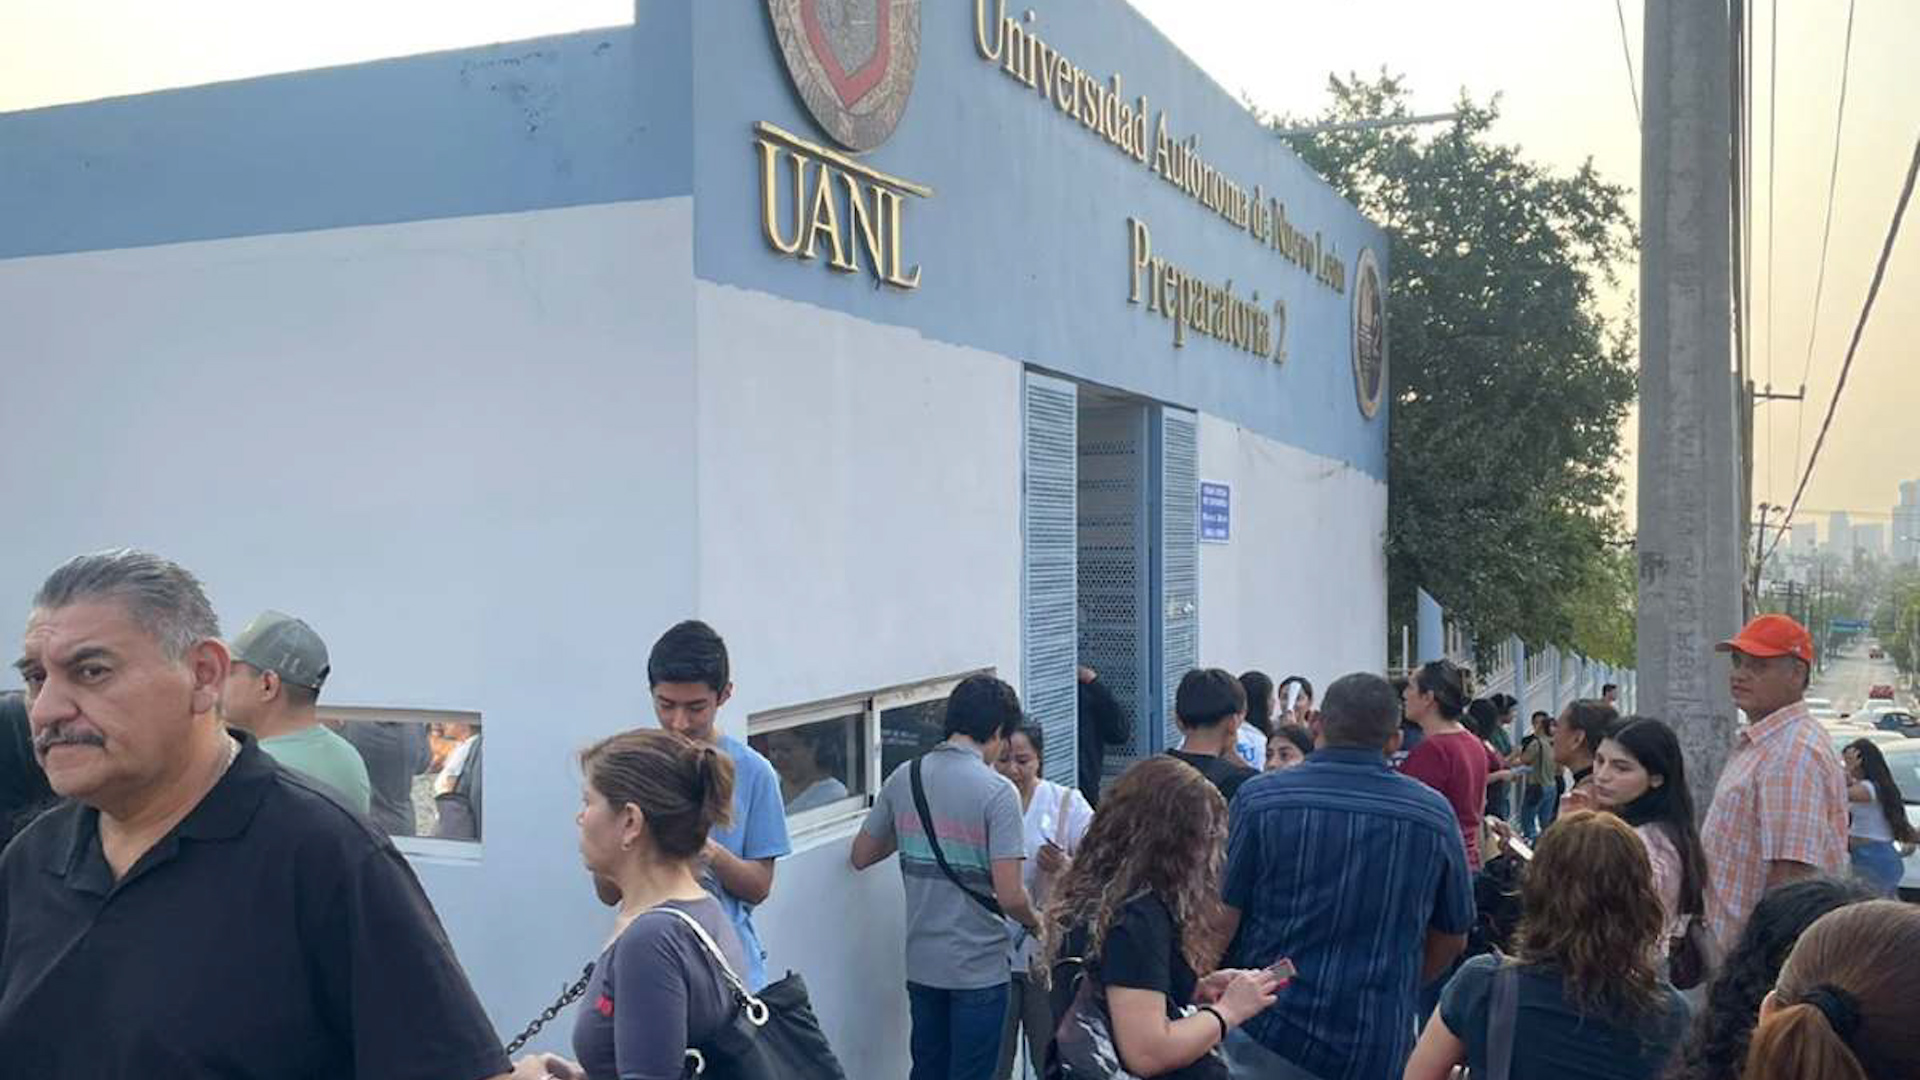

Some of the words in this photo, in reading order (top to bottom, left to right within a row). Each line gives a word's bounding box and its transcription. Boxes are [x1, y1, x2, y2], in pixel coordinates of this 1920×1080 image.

[756, 139, 922, 290] UANL
[973, 0, 1148, 163] Universidad
[1149, 109, 1250, 230] Autónoma
[1251, 184, 1271, 243] de
[1271, 198, 1314, 274] Nuevo
[1314, 231, 1345, 295] León
[1127, 217, 1271, 358] Preparatoria
[1273, 300, 1288, 365] 2
